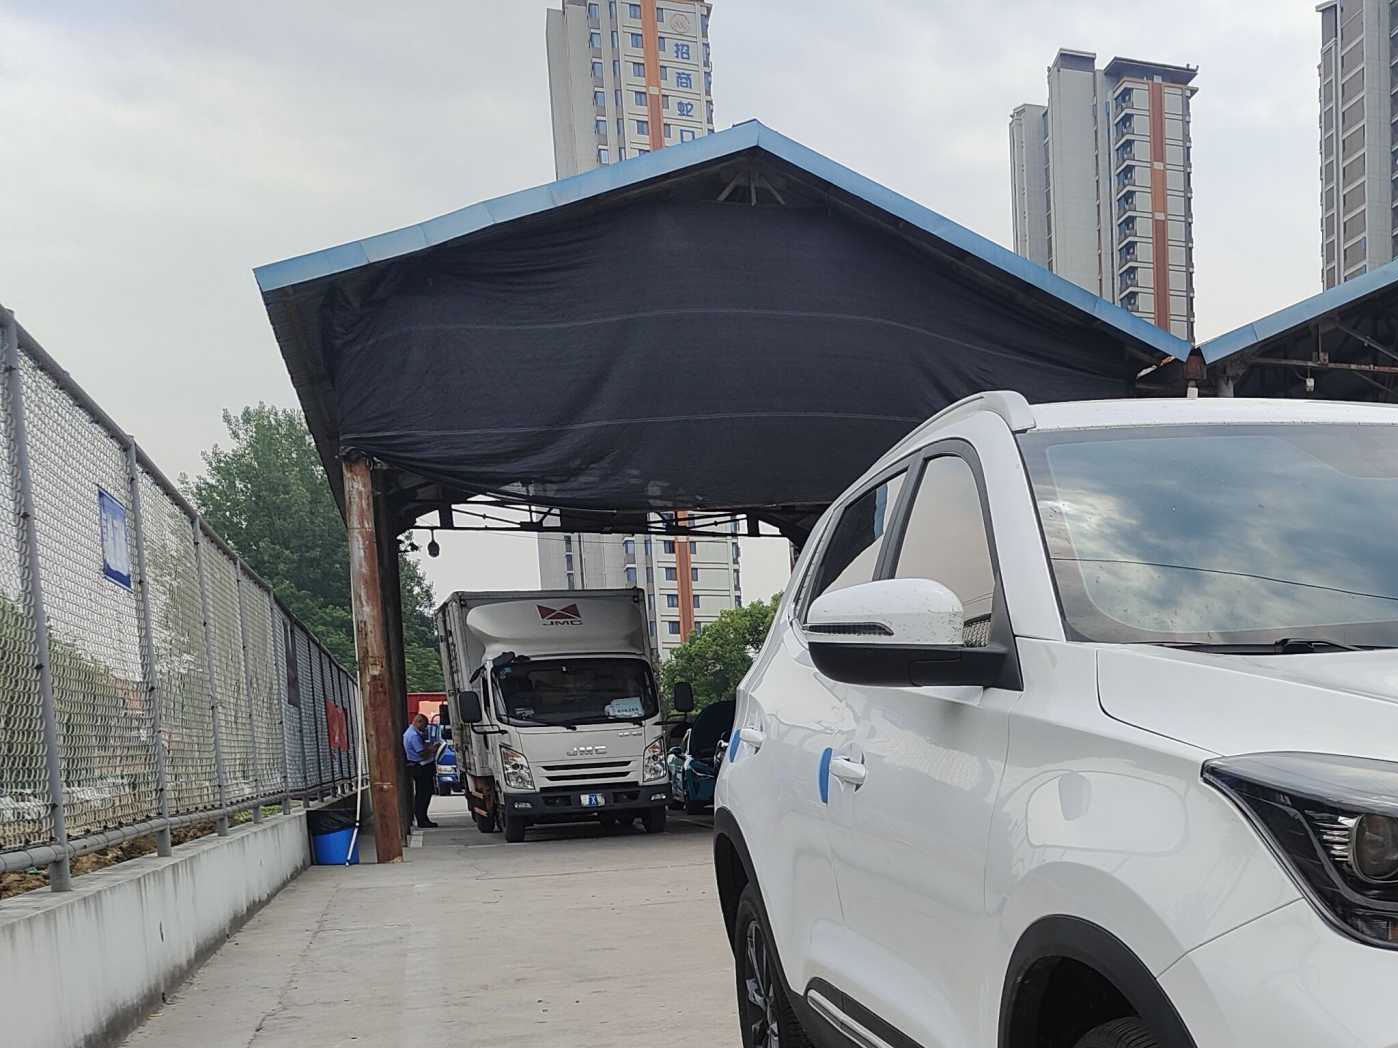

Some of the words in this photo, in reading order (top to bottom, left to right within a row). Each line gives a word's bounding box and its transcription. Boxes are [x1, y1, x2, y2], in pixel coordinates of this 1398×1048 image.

[674, 42, 695, 144] 招商蛇口
[567, 746, 607, 756] JMC
